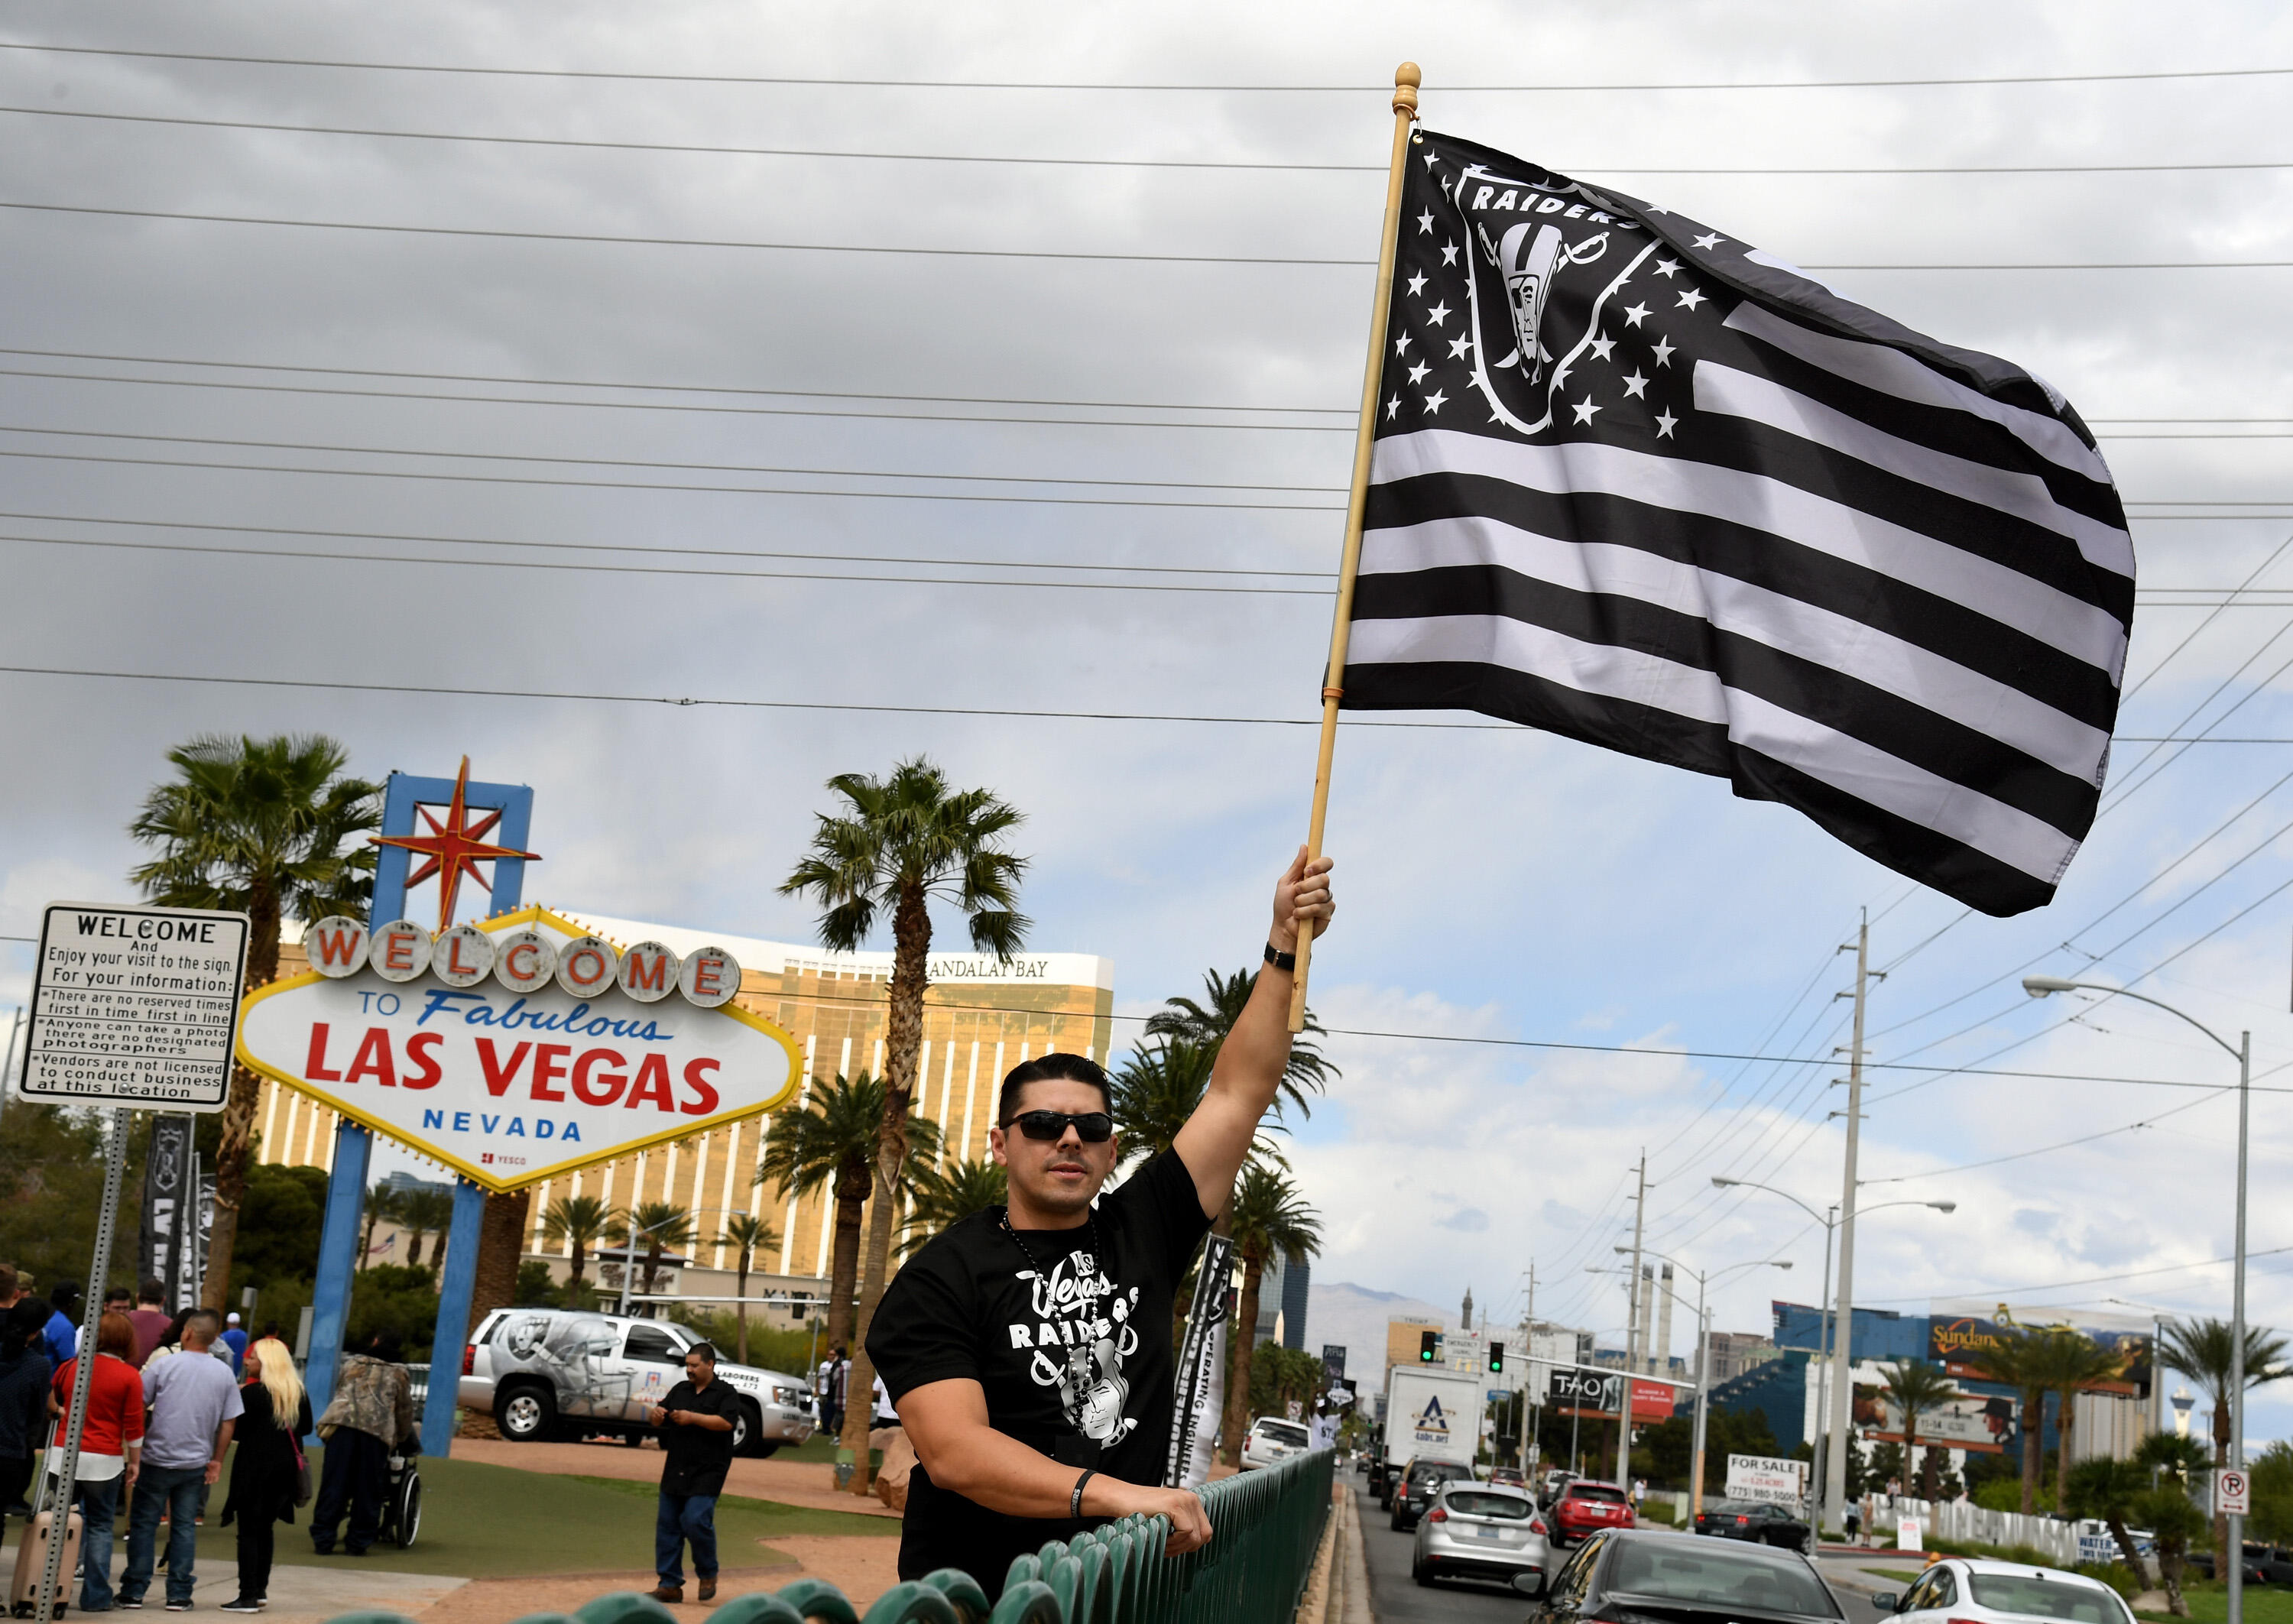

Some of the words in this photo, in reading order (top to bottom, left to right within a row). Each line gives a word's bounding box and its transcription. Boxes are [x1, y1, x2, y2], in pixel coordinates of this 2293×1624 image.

[1472, 186, 1641, 229] RAIDERS
[78, 915, 216, 943] WELCOME
[131, 941, 158, 952] And
[49, 947, 86, 964] Enjoy
[92, 952, 122, 966] your
[127, 953, 155, 967] visit
[161, 955, 173, 968] to
[179, 955, 199, 969] the
[204, 959, 232, 975] sign.
[318, 928, 725, 995] WELCOME
[926, 961, 1008, 977] ANDALAY
[1015, 961, 1048, 977] BAY
[53, 968, 79, 981] For
[86, 972, 125, 987] your
[131, 973, 232, 991] information:
[52, 990, 86, 1002] There
[92, 994, 112, 1004] are
[118, 997, 132, 1005] no
[138, 997, 191, 1009] reserved
[197, 999, 230, 1011] times
[49, 1003, 79, 1015] first
[86, 1005, 99, 1016] in
[105, 1006, 138, 1019] time
[148, 1010, 177, 1022] first
[184, 1012, 196, 1023] in
[203, 1013, 229, 1024] line
[358, 991, 401, 1016] TO
[417, 989, 674, 1041] Fabulous
[46, 1029, 86, 1039] there
[146, 1033, 225, 1048] designated
[47, 1019, 101, 1030] Anyone
[107, 1023, 131, 1031] can
[138, 1024, 167, 1033] take
[187, 1027, 226, 1038] photo
[44, 1039, 186, 1055] photographers
[42, 1055, 99, 1067] Vendors
[106, 1059, 128, 1069] are
[135, 1061, 157, 1070] not
[165, 1061, 222, 1075] licensed
[305, 1023, 444, 1091] LAS
[475, 1037, 721, 1116] VEGAS
[37, 1080, 56, 1090] at
[66, 1082, 102, 1093] this
[41, 1066, 57, 1077] to
[65, 1069, 135, 1081] conduct
[144, 1072, 220, 1087] business
[423, 1110, 581, 1143] NEVADA
[498, 1156, 526, 1165] YESCO
[1015, 1258, 1118, 1319] Vegas
[1194, 1331, 1215, 1409] OPERATING
[1553, 1375, 1601, 1396] TAO
[1179, 1414, 1201, 1480] ENGINEERS
[1731, 1457, 1757, 1469] FOR
[1762, 1460, 1795, 1473] SALE
